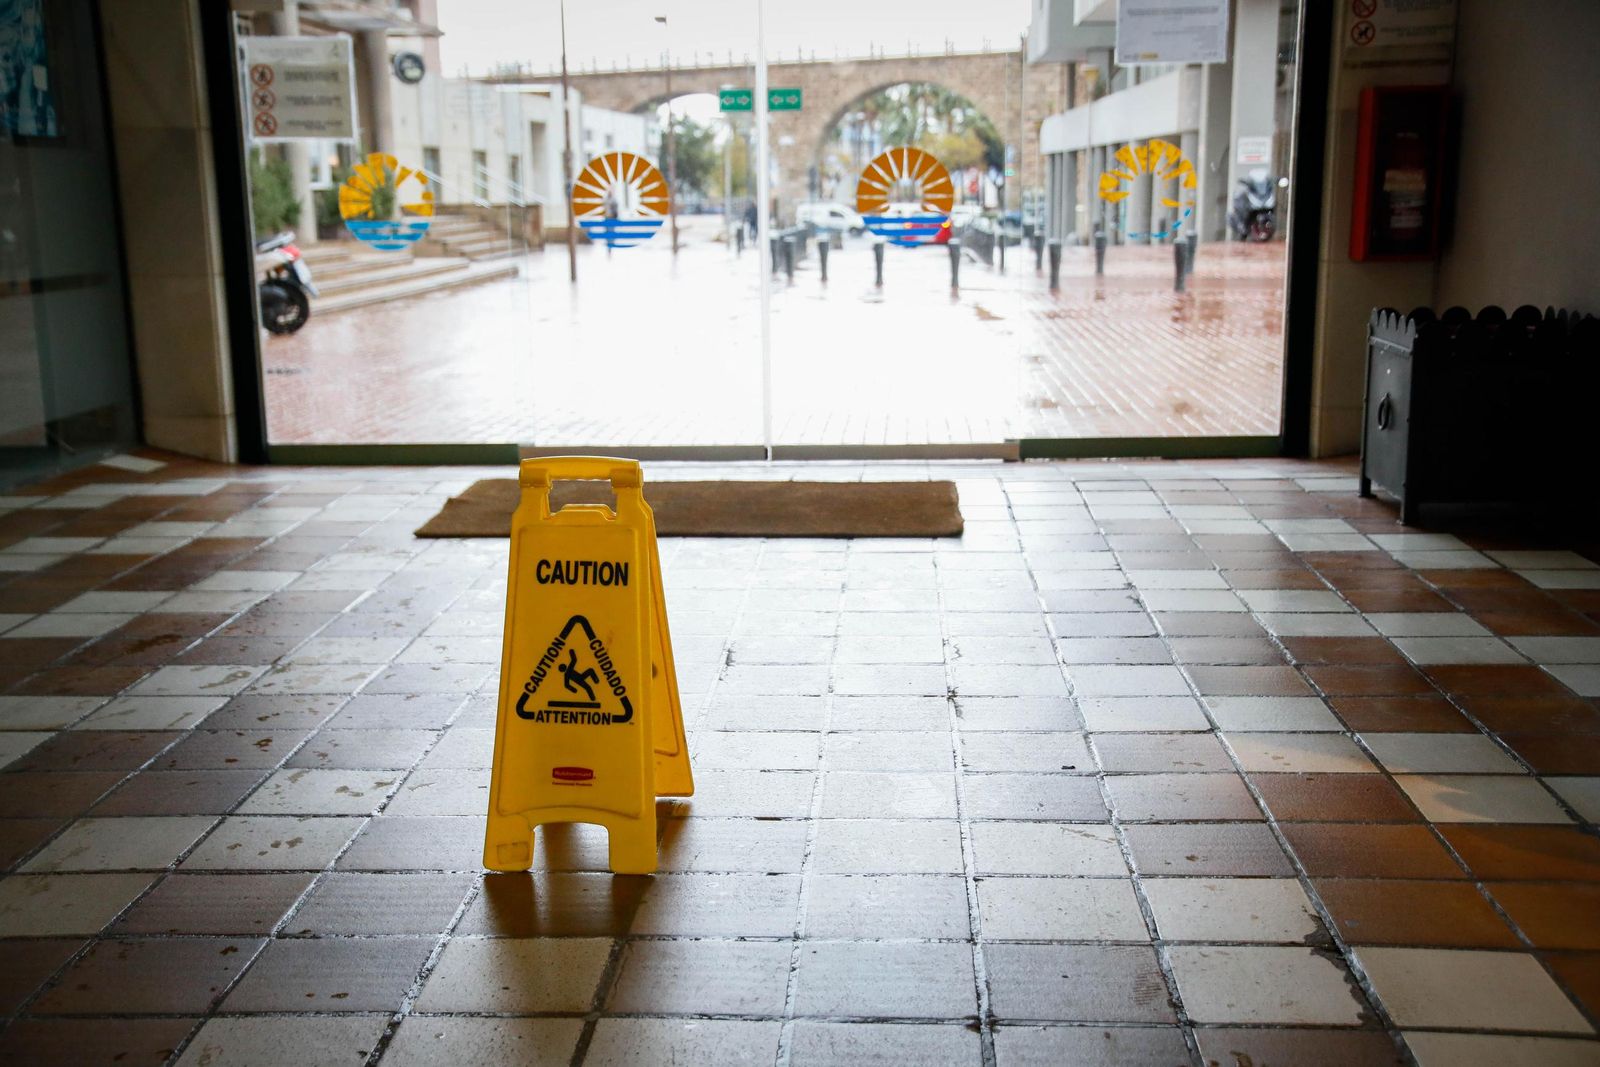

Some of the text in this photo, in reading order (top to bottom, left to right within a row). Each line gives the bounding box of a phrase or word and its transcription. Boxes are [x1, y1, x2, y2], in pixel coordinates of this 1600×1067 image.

[536, 560, 628, 586] CAUTION
[524, 637, 566, 694] CAUTION
[590, 639, 626, 697] CUIDADO
[535, 710, 611, 725] ATTENTION
